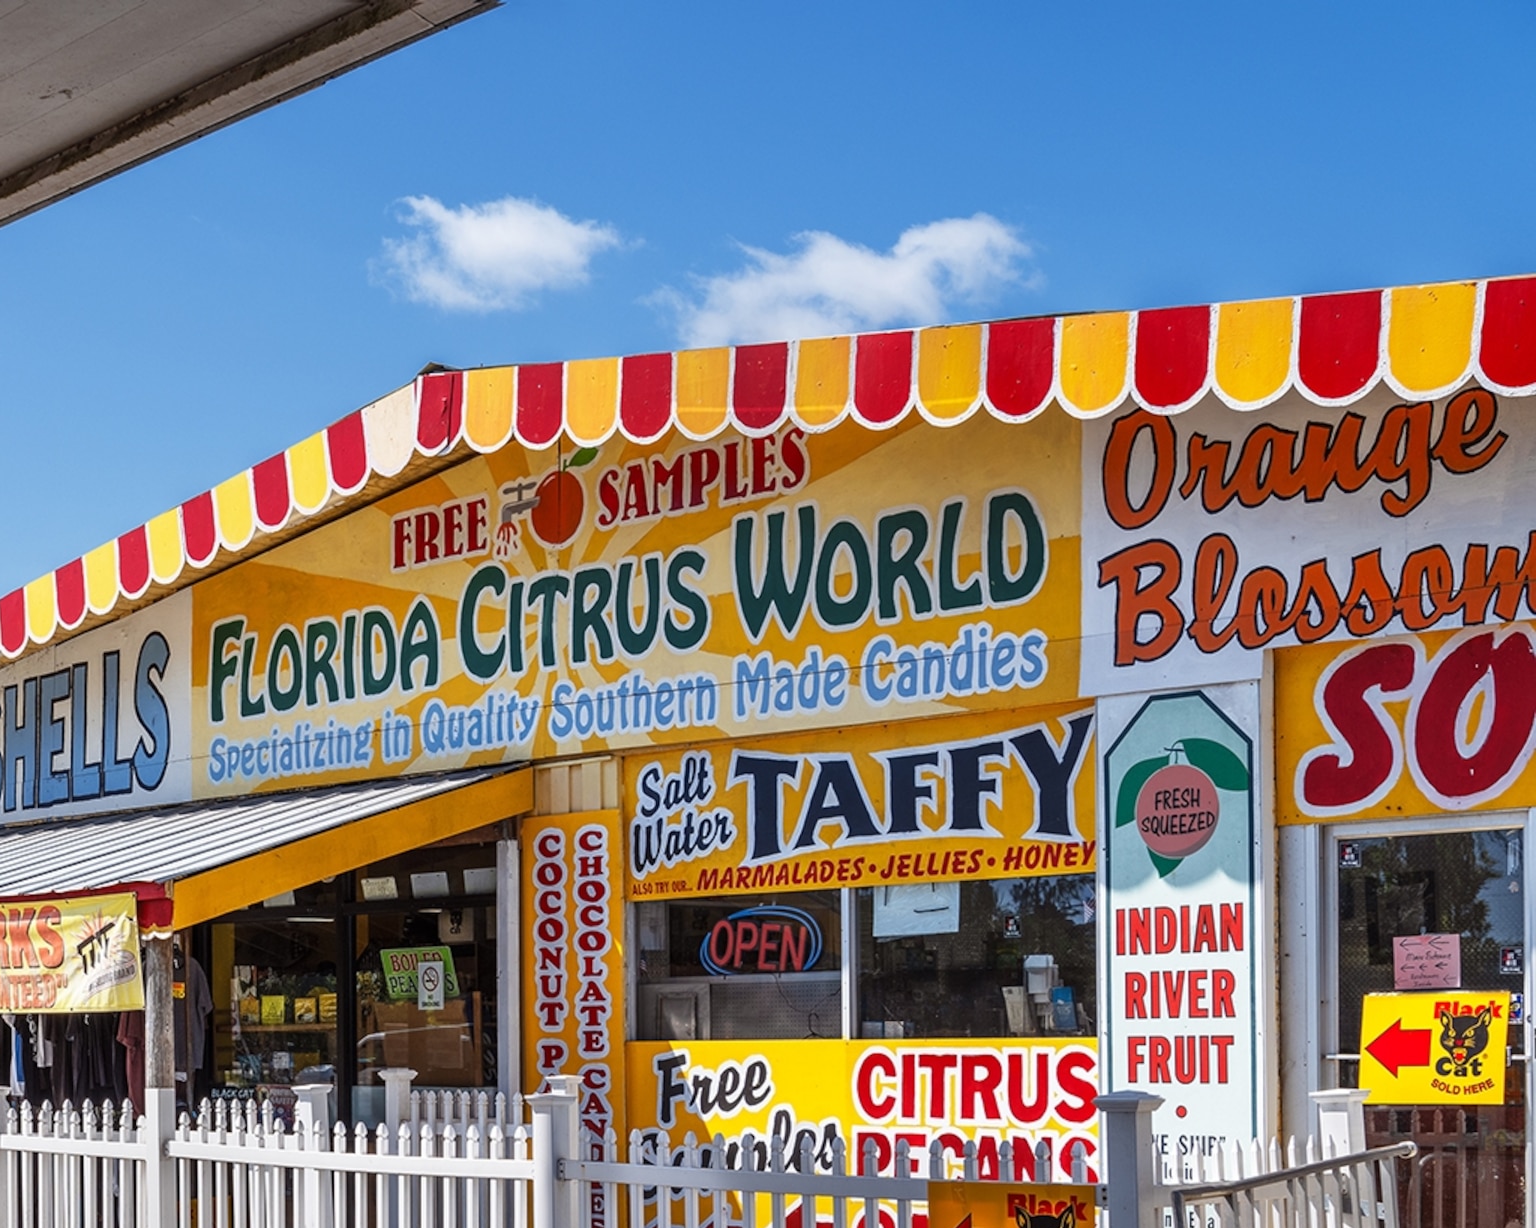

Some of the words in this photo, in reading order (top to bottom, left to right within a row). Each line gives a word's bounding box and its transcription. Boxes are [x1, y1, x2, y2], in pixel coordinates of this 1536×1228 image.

[1102, 388, 1509, 529] Orange
[392, 498, 488, 570] FREE
[597, 428, 808, 527] SAMPLES
[210, 600, 439, 723] FLORIDA
[462, 550, 708, 679] CITRUS
[734, 492, 1046, 640] WORLD
[208, 715, 372, 783] Specializing
[383, 708, 411, 760] in
[423, 692, 538, 754] Quality
[550, 671, 717, 739] Southern
[736, 648, 846, 719] Made
[865, 627, 1045, 702] Candies
[641, 756, 712, 818] Salt
[734, 712, 1095, 861] TAFFY
[1154, 788, 1201, 810] FRESH
[634, 811, 733, 873] Water
[1141, 810, 1216, 835] SQUEEZED
[632, 881, 653, 896] ALSO
[655, 880, 671, 894] TRY
[696, 857, 865, 891] MARMALADES
[880, 849, 985, 880] JELLIES
[1002, 841, 1096, 872] HONEY
[537, 833, 565, 1028] COCONUT
[577, 829, 608, 1053] CHOCOLATE
[709, 918, 808, 974] OPEN
[1116, 902, 1245, 956] INDIAN
[1124, 968, 1237, 1019] RIVER
[1433, 1000, 1503, 1020] Black
[657, 1054, 772, 1124] Free
[856, 1051, 1099, 1125] CITRUS
[1127, 1035, 1235, 1085] FRUIT
[1430, 1078, 1461, 1096] SOLD
[1463, 1077, 1496, 1096] HERE
[1434, 1056, 1483, 1077] Cat
[1007, 1192, 1089, 1221] Black
